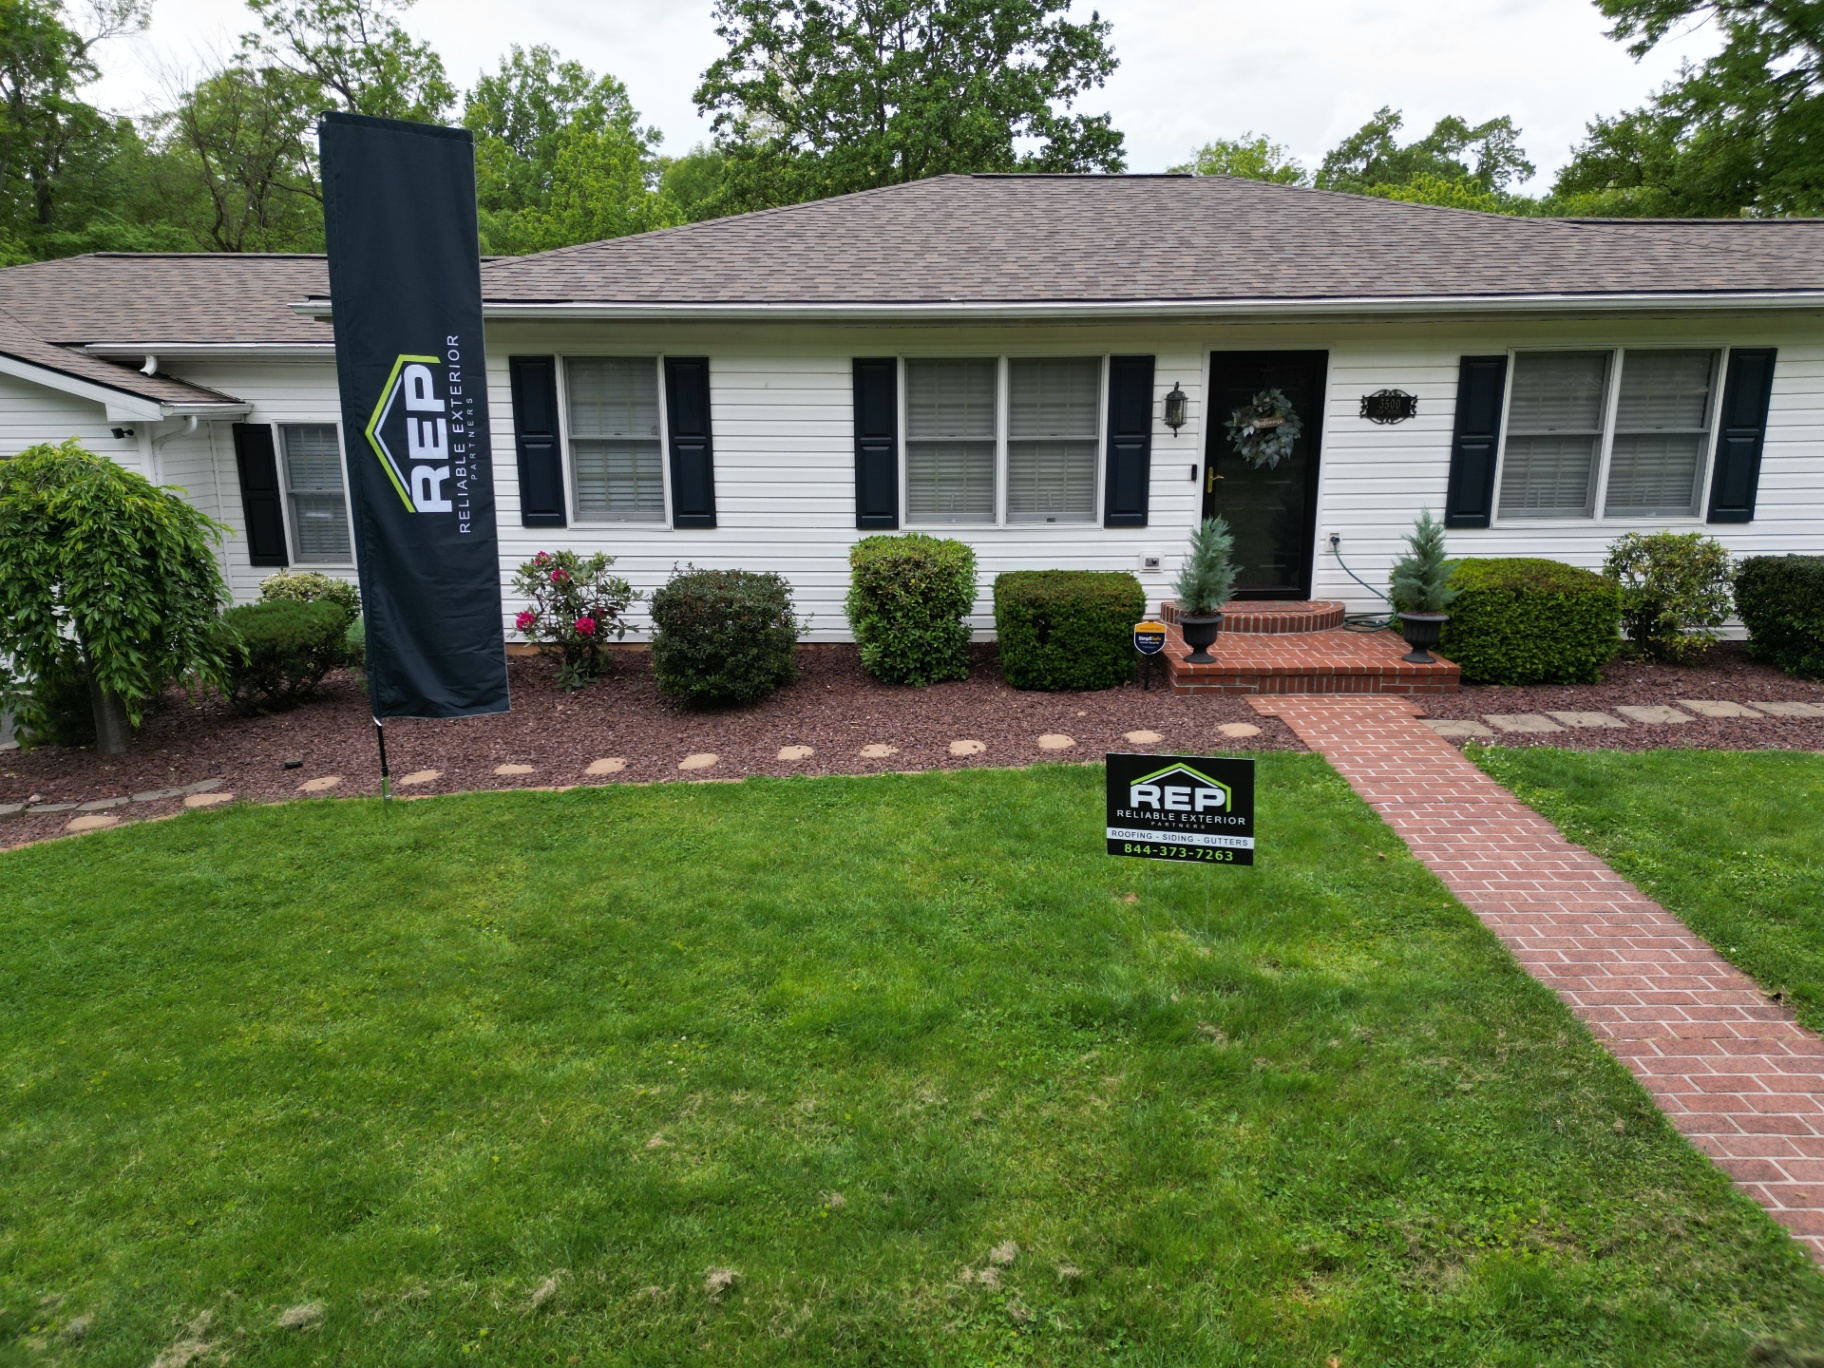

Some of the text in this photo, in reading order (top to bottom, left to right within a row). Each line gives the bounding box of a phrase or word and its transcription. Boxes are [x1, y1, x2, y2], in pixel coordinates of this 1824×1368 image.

[1379, 399, 1401, 410] 3500
[403, 364, 453, 513] REP
[447, 335, 471, 533] RELIABLE EXTERIOR
[466, 398, 477, 480] PARTNERS
[1130, 784, 1226, 812] REP
[1116, 809, 1246, 826] RELIABLE EXTERIOR
[1150, 821, 1206, 830] PARTNERS
[1111, 830, 1153, 840] ROOFING
[1162, 834, 1194, 843] SIDING
[1203, 837, 1249, 847] GUTTERS
[1124, 843, 1234, 862] 844-373-7263
